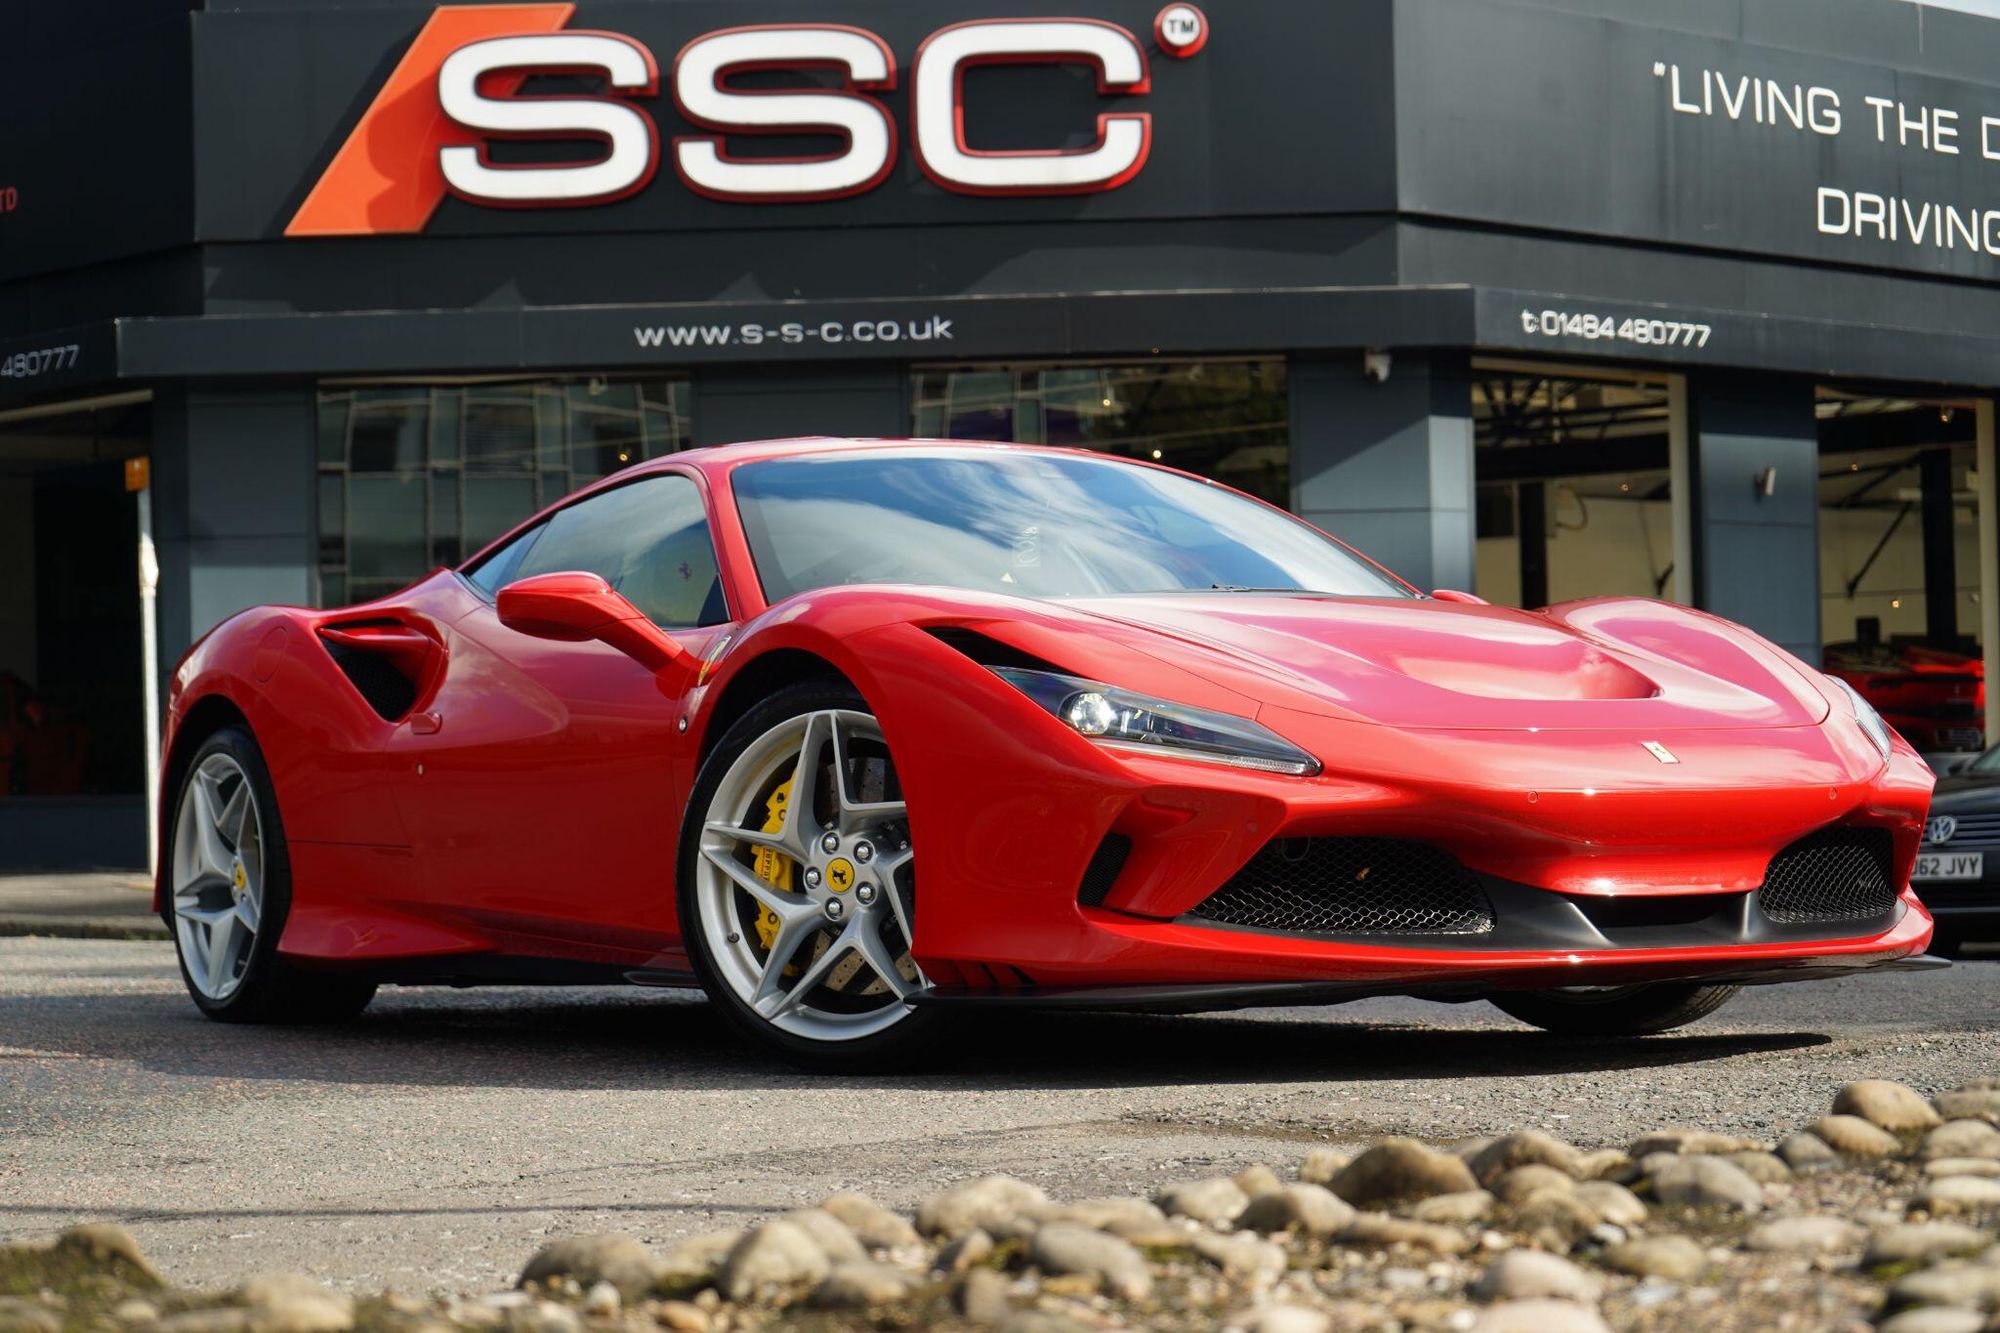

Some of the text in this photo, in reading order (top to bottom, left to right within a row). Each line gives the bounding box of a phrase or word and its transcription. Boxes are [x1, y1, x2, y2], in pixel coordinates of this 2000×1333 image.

[1168, 19, 1194, 34] TM
[437, 18, 1152, 208] SSC
[1864, 96, 1960, 154] THE
[633, 315, 953, 347] www.s-s-c.co.uk
[1618, 317, 1712, 348] 480777
[0, 344, 80, 378] 480777
[1945, 856, 1979, 875] JVY
